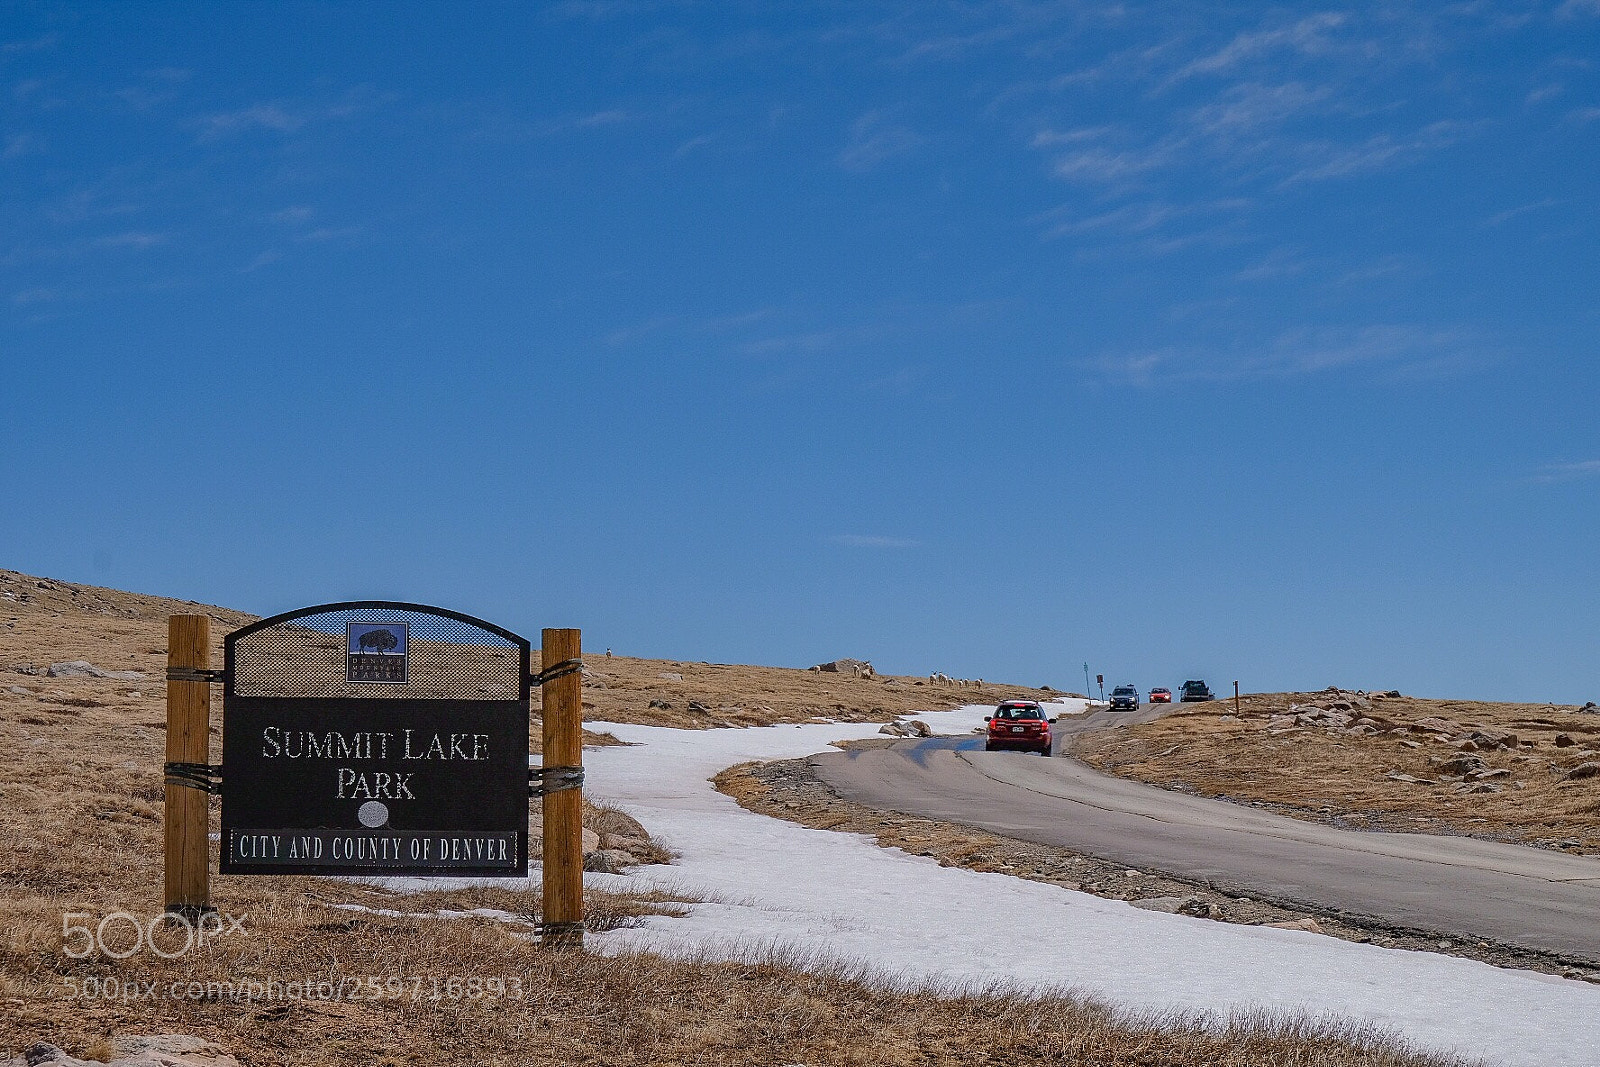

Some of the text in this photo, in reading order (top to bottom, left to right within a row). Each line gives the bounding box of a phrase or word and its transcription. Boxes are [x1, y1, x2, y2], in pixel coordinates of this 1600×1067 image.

[262, 726, 490, 760] SUMMIT LAKE
[335, 767, 416, 799] PARK
[239, 834, 508, 861] CITY AND COUNTY OF DENVER
